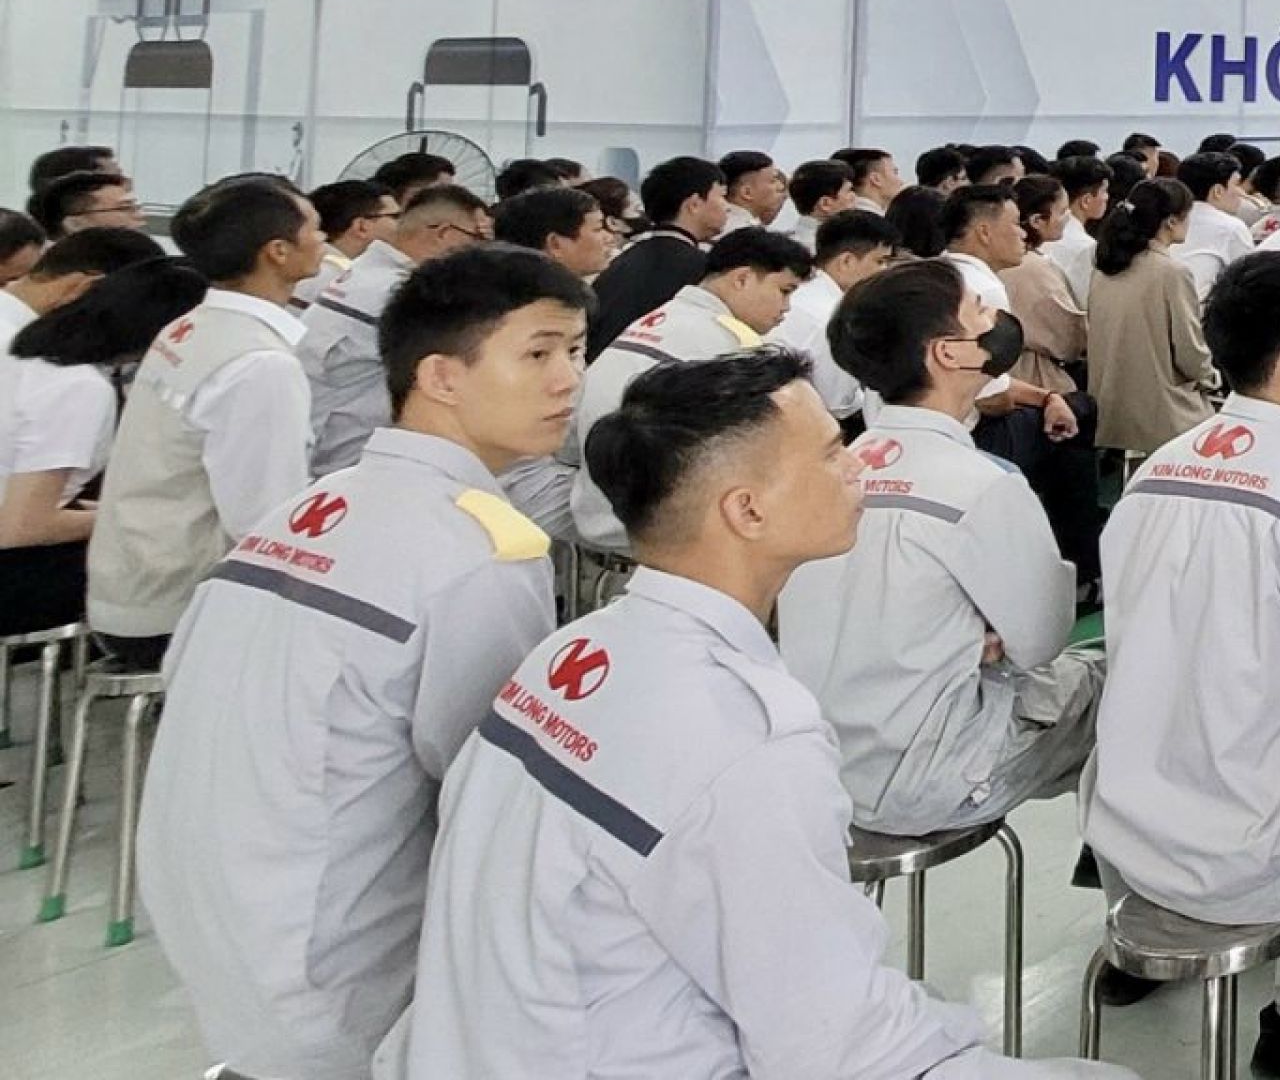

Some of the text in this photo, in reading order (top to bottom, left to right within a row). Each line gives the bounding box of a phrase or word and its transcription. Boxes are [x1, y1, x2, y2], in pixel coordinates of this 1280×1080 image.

[1175, 464, 1213, 480] LONG
[1214, 468, 1270, 490] MOTORS
[541, 712, 599, 762] MOTORS
